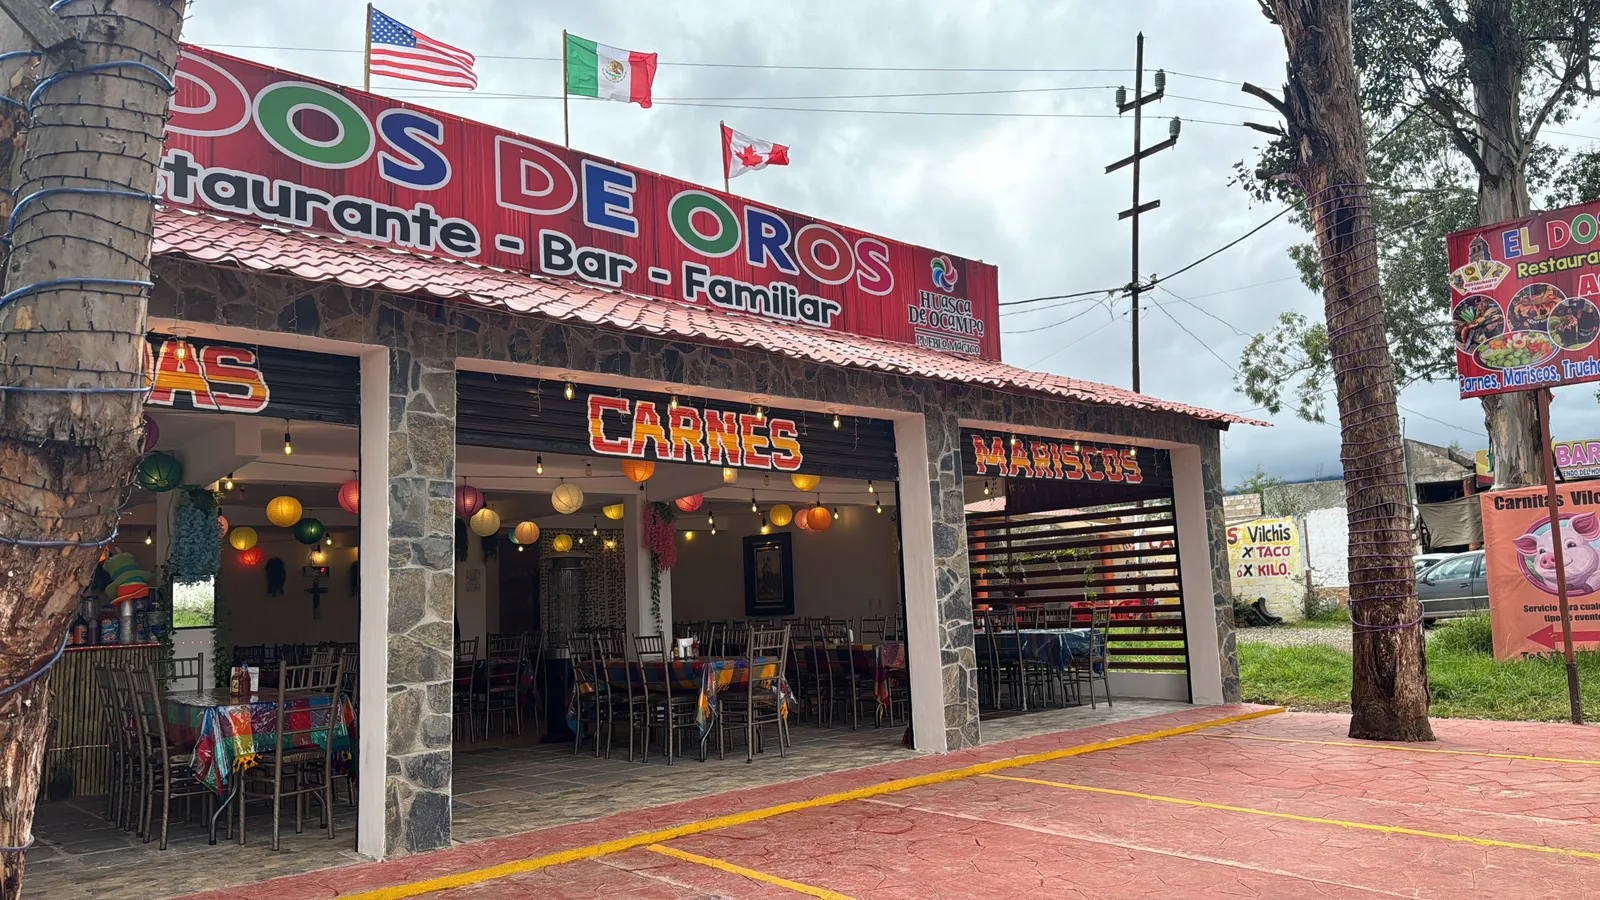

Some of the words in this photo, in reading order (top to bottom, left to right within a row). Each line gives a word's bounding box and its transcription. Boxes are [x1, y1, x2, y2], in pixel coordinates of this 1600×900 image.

[164, 51, 452, 191] DOS
[494, 134, 639, 238] DE
[667, 189, 895, 297] OROS
[157, 148, 481, 258] taurante
[538, 228, 638, 288] Bar
[681, 261, 842, 329] Familiar
[1502, 226, 1540, 260] EL
[1546, 213, 1600, 251] DO
[144, 340, 271, 414] AS
[1458, 373, 1501, 394] Carnes,
[1502, 364, 1561, 388] Mariscos,
[587, 393, 803, 472] CARNES
[970, 434, 1144, 485] MARISCOS
[1241, 546, 1254, 559] X
[1256, 545, 1291, 558] TACO
[1247, 523, 1291, 544] Vilchis
[1257, 562, 1291, 577] KILO.
[1523, 604, 1558, 613] Servicio
